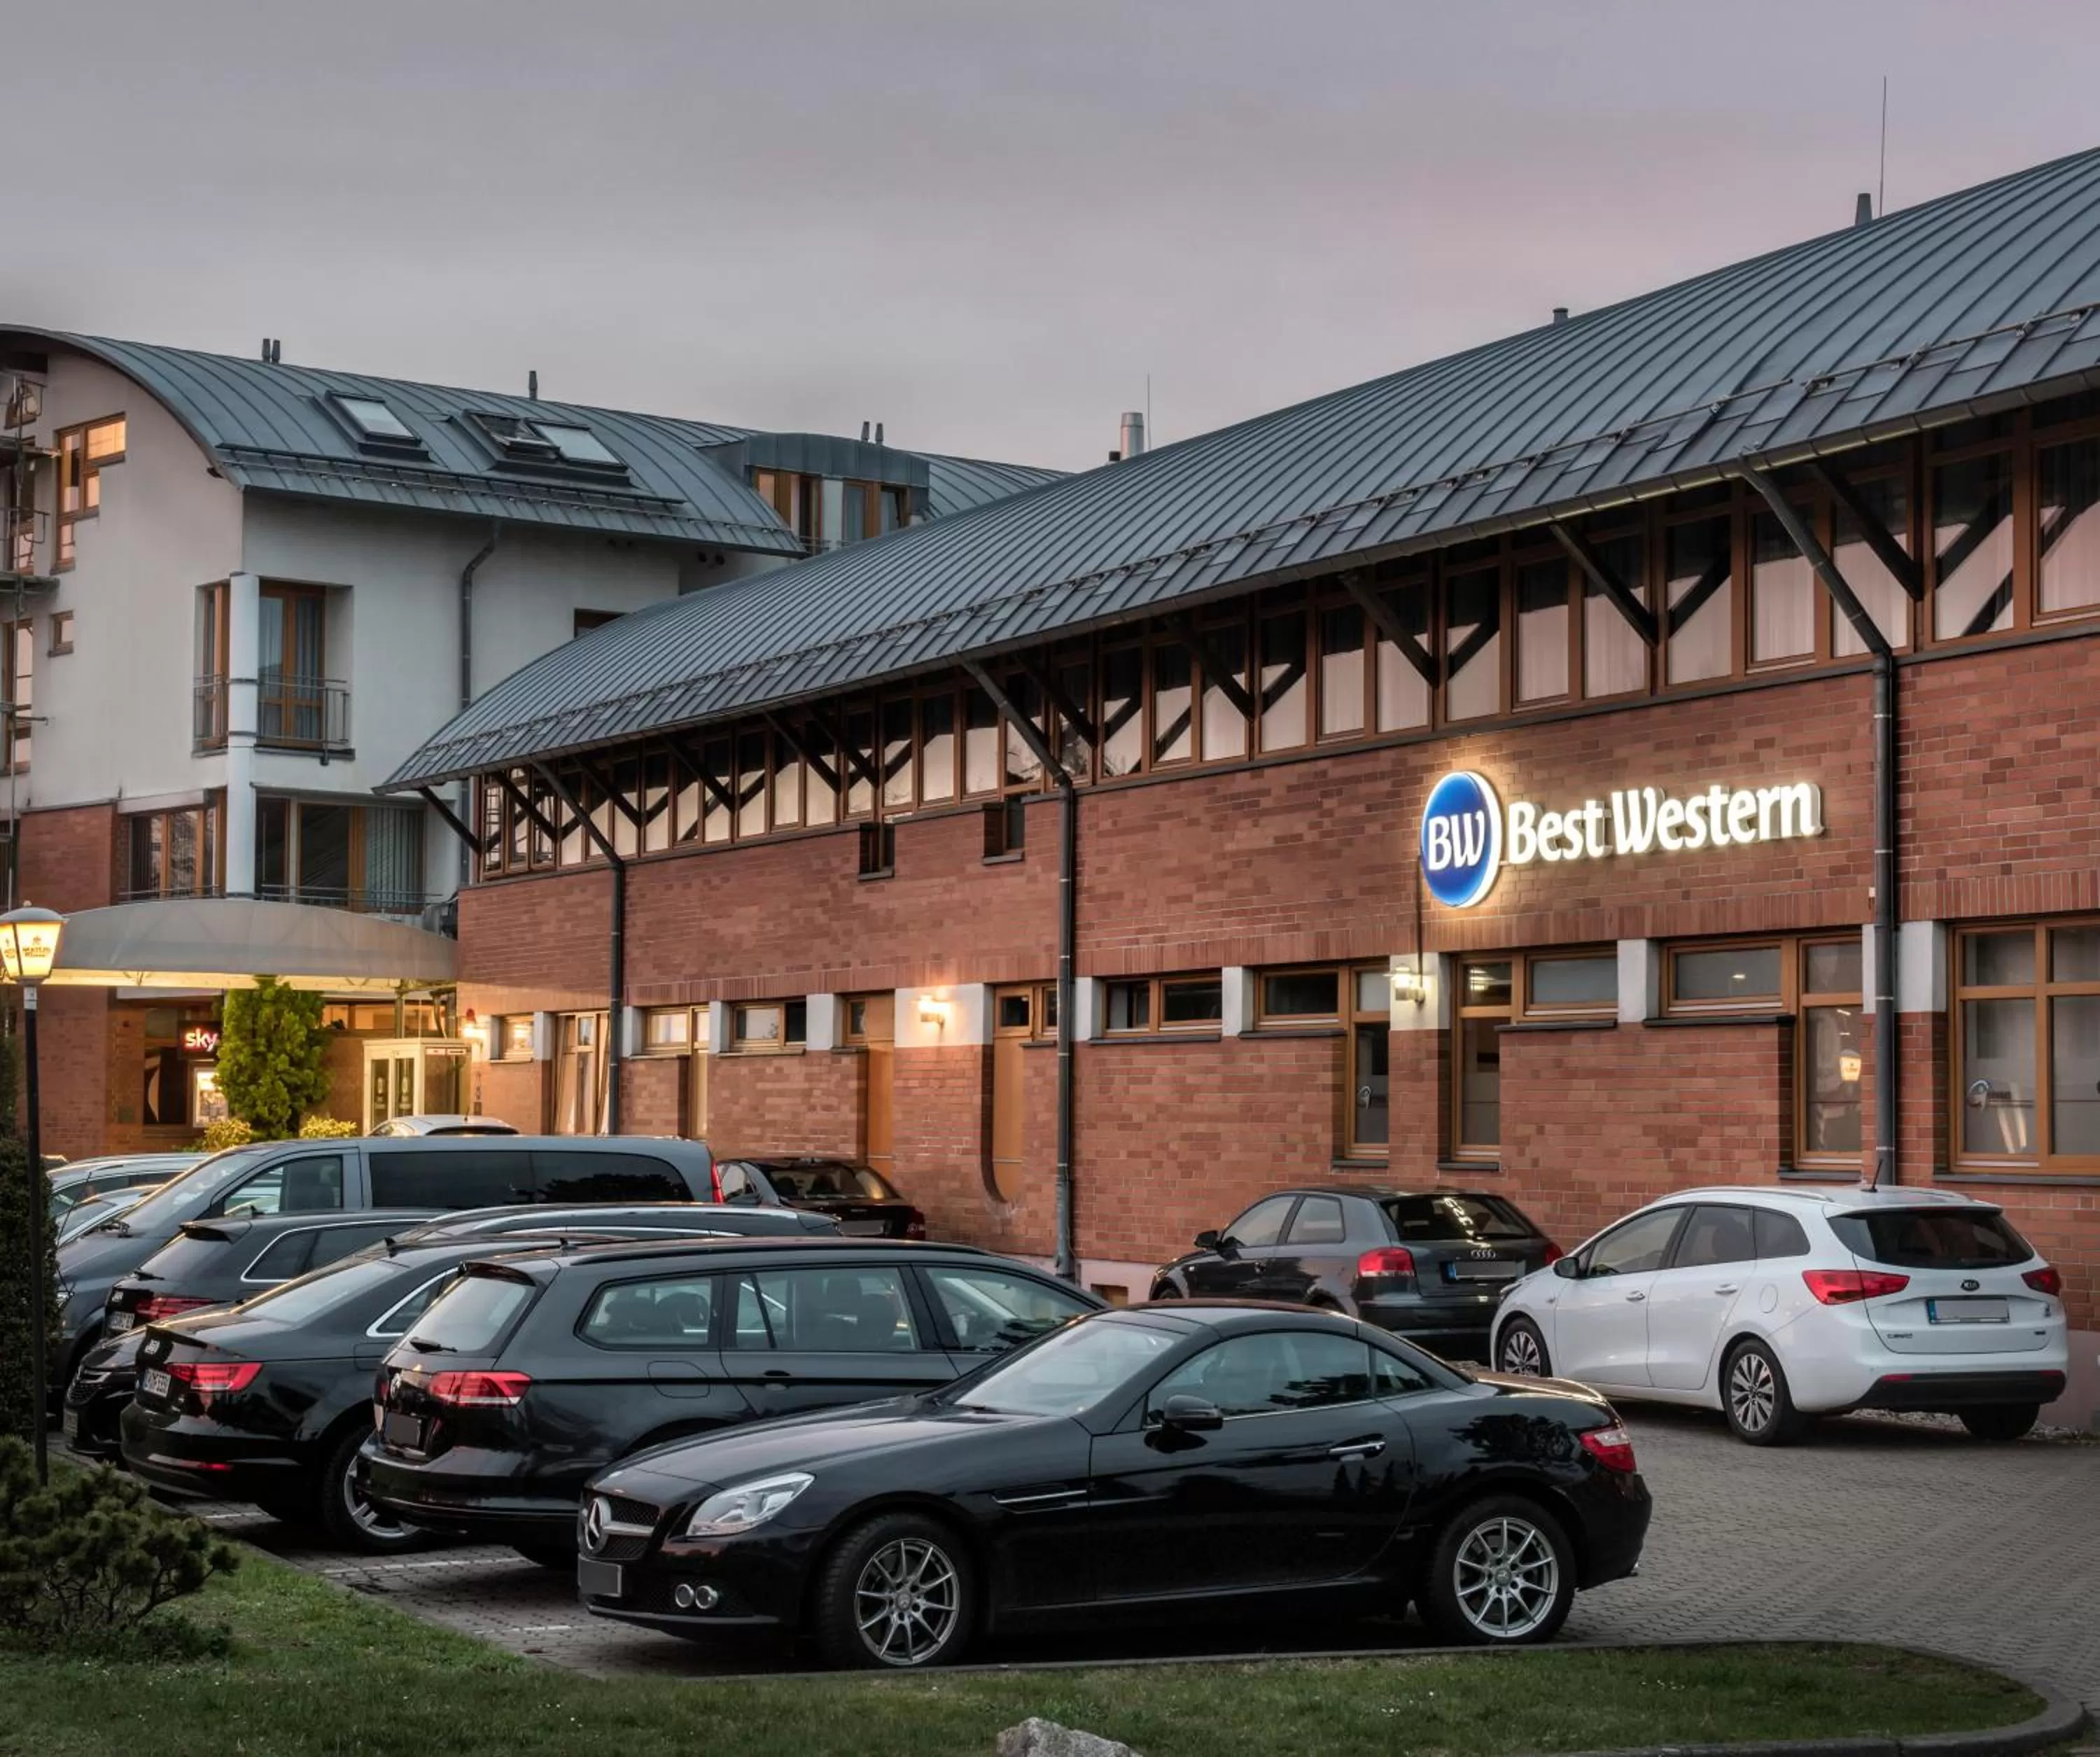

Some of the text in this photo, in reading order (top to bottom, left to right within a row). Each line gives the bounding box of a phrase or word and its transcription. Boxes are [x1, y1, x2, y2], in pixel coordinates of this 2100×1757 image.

[1427, 783, 1823, 871] BW Best Western
[186, 1028, 218, 1051] sky
